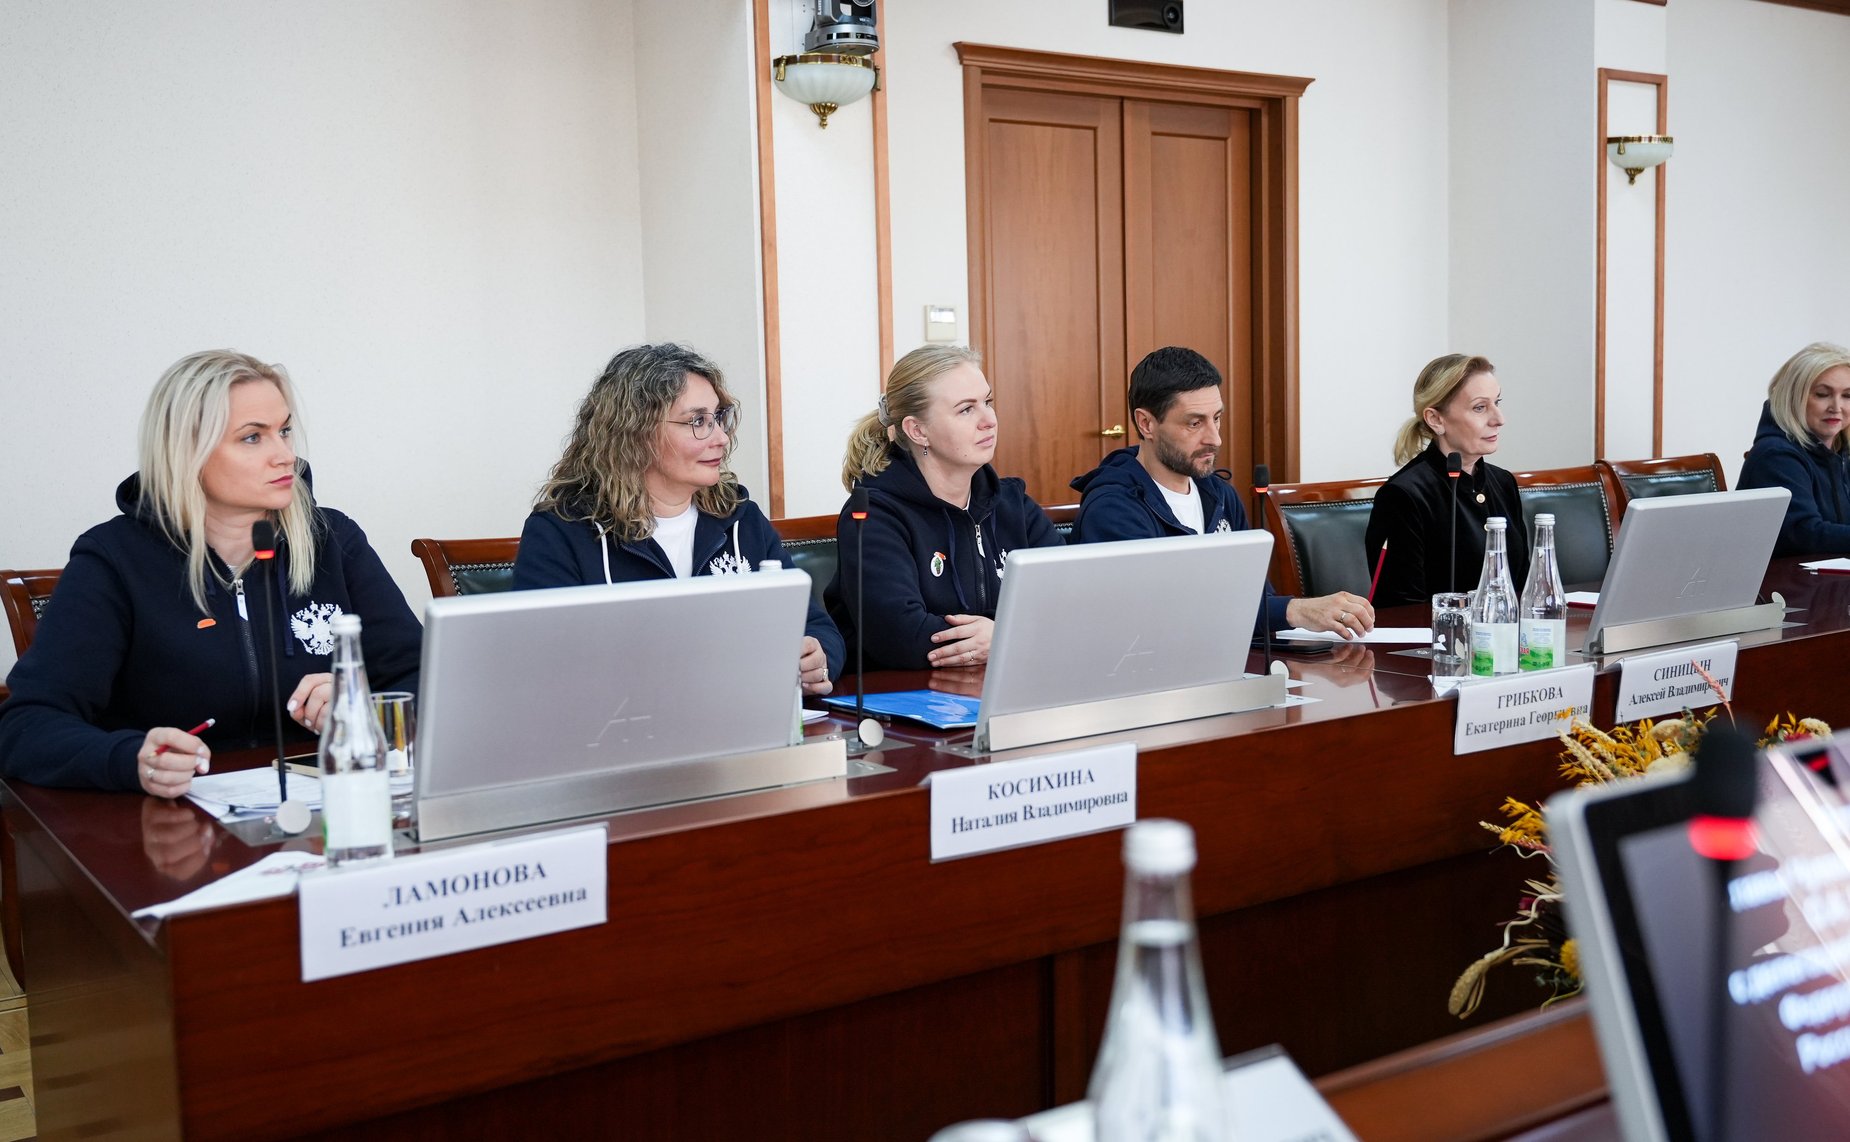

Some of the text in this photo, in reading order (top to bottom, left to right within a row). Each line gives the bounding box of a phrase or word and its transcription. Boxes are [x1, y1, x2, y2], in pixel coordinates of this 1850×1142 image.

[1497, 686, 1563, 709] ГРИБКОВА
[1629, 688, 1666, 706] Алексей
[1465, 715, 1526, 736] Екатерина
[988, 768, 1095, 800] КОСИХИНА
[951, 791, 1128, 834] Наталия Владимировна
[382, 862, 547, 908] ЛАМОНОВА
[339, 888, 587, 947] Евгения Алексеевна
